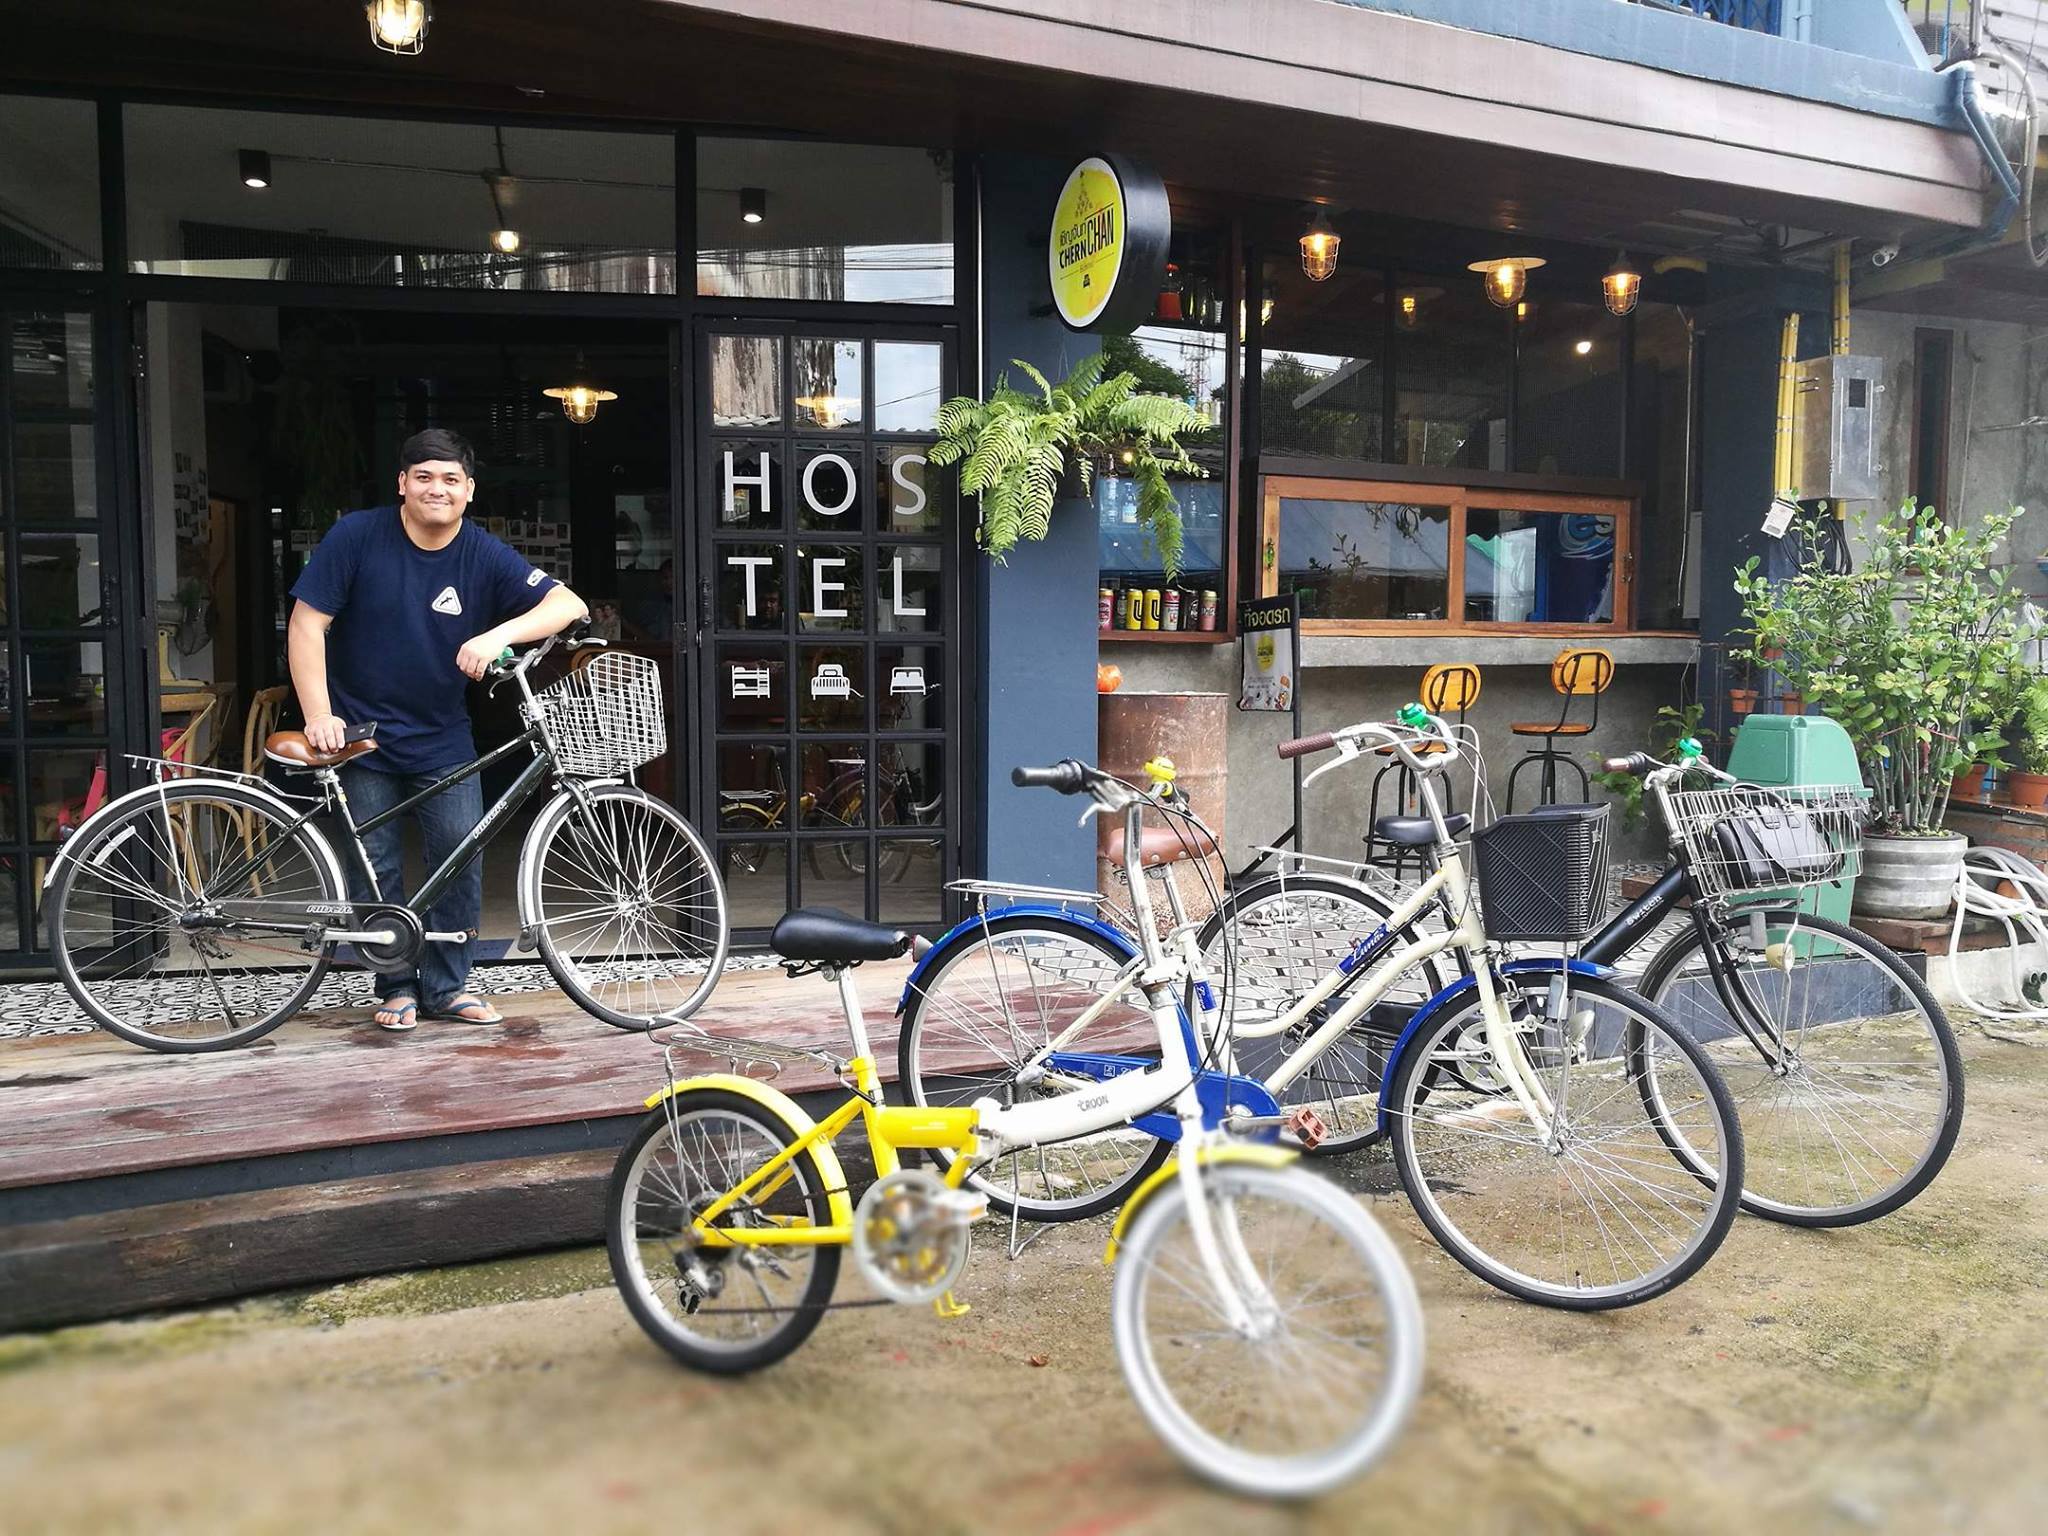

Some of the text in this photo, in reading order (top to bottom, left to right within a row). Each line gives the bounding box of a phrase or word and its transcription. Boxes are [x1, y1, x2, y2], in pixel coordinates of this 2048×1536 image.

[1059, 207, 1114, 269] CHERN CHAN
[723, 451, 927, 516] HOS
[727, 556, 926, 617] TEL
